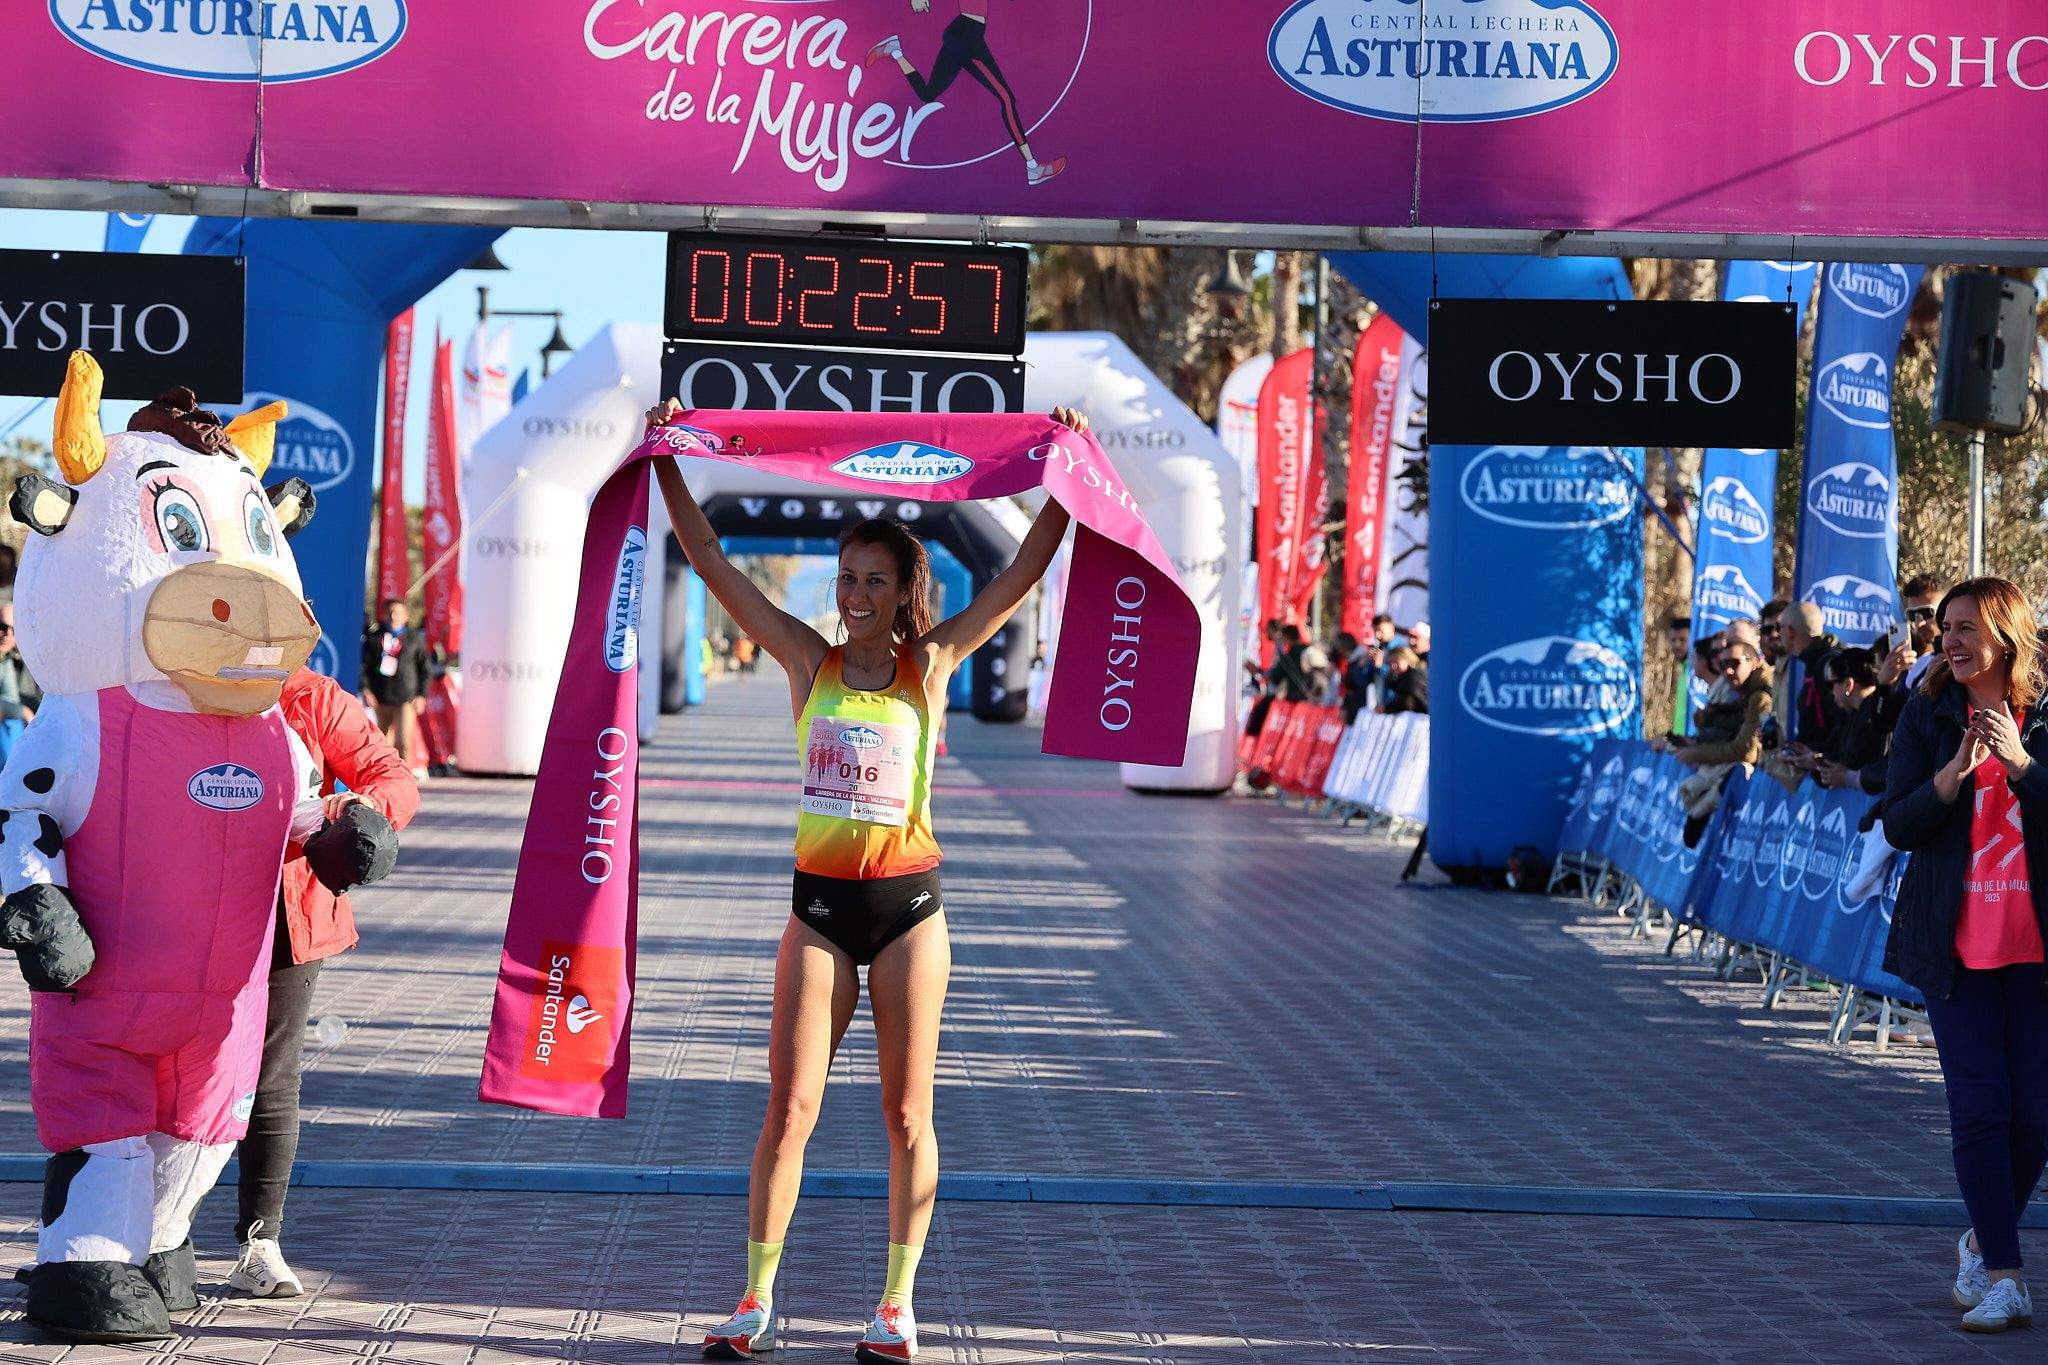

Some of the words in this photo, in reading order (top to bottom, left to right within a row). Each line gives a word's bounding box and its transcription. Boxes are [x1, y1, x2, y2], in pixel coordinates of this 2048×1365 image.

[583, 0, 848, 70] Carrera
[1295, 16, 1591, 80] ASTURIANA
[1351, 14, 1458, 30] CENTRAL
[1471, 16, 1580, 32] LECHERA
[1794, 30, 2048, 91] OYSHO
[645, 68, 696, 122] de
[706, 68, 741, 124] la
[731, 64, 945, 192] Mujer
[690, 249, 1002, 334] 00:22:57
[0, 300, 190, 355] YSHO
[679, 357, 1006, 414] OYSHO
[1488, 350, 1742, 404] OYSHO
[522, 416, 617, 440] OYSHO
[1361, 347, 1400, 516] Santander
[842, 462, 963, 476] ASTURIANA
[738, 497, 923, 521] VOLVO
[609, 539, 644, 660] ASTURIANA
[1099, 576, 1147, 732] OYSHO
[841, 732, 881, 746] ASTURIANA
[194, 780, 259, 798] ASTURIANA
[839, 763, 878, 782] 016
[581, 726, 628, 885] OYSHO
[811, 800, 843, 811] OYSHO
[535, 955, 570, 1066] Santander
